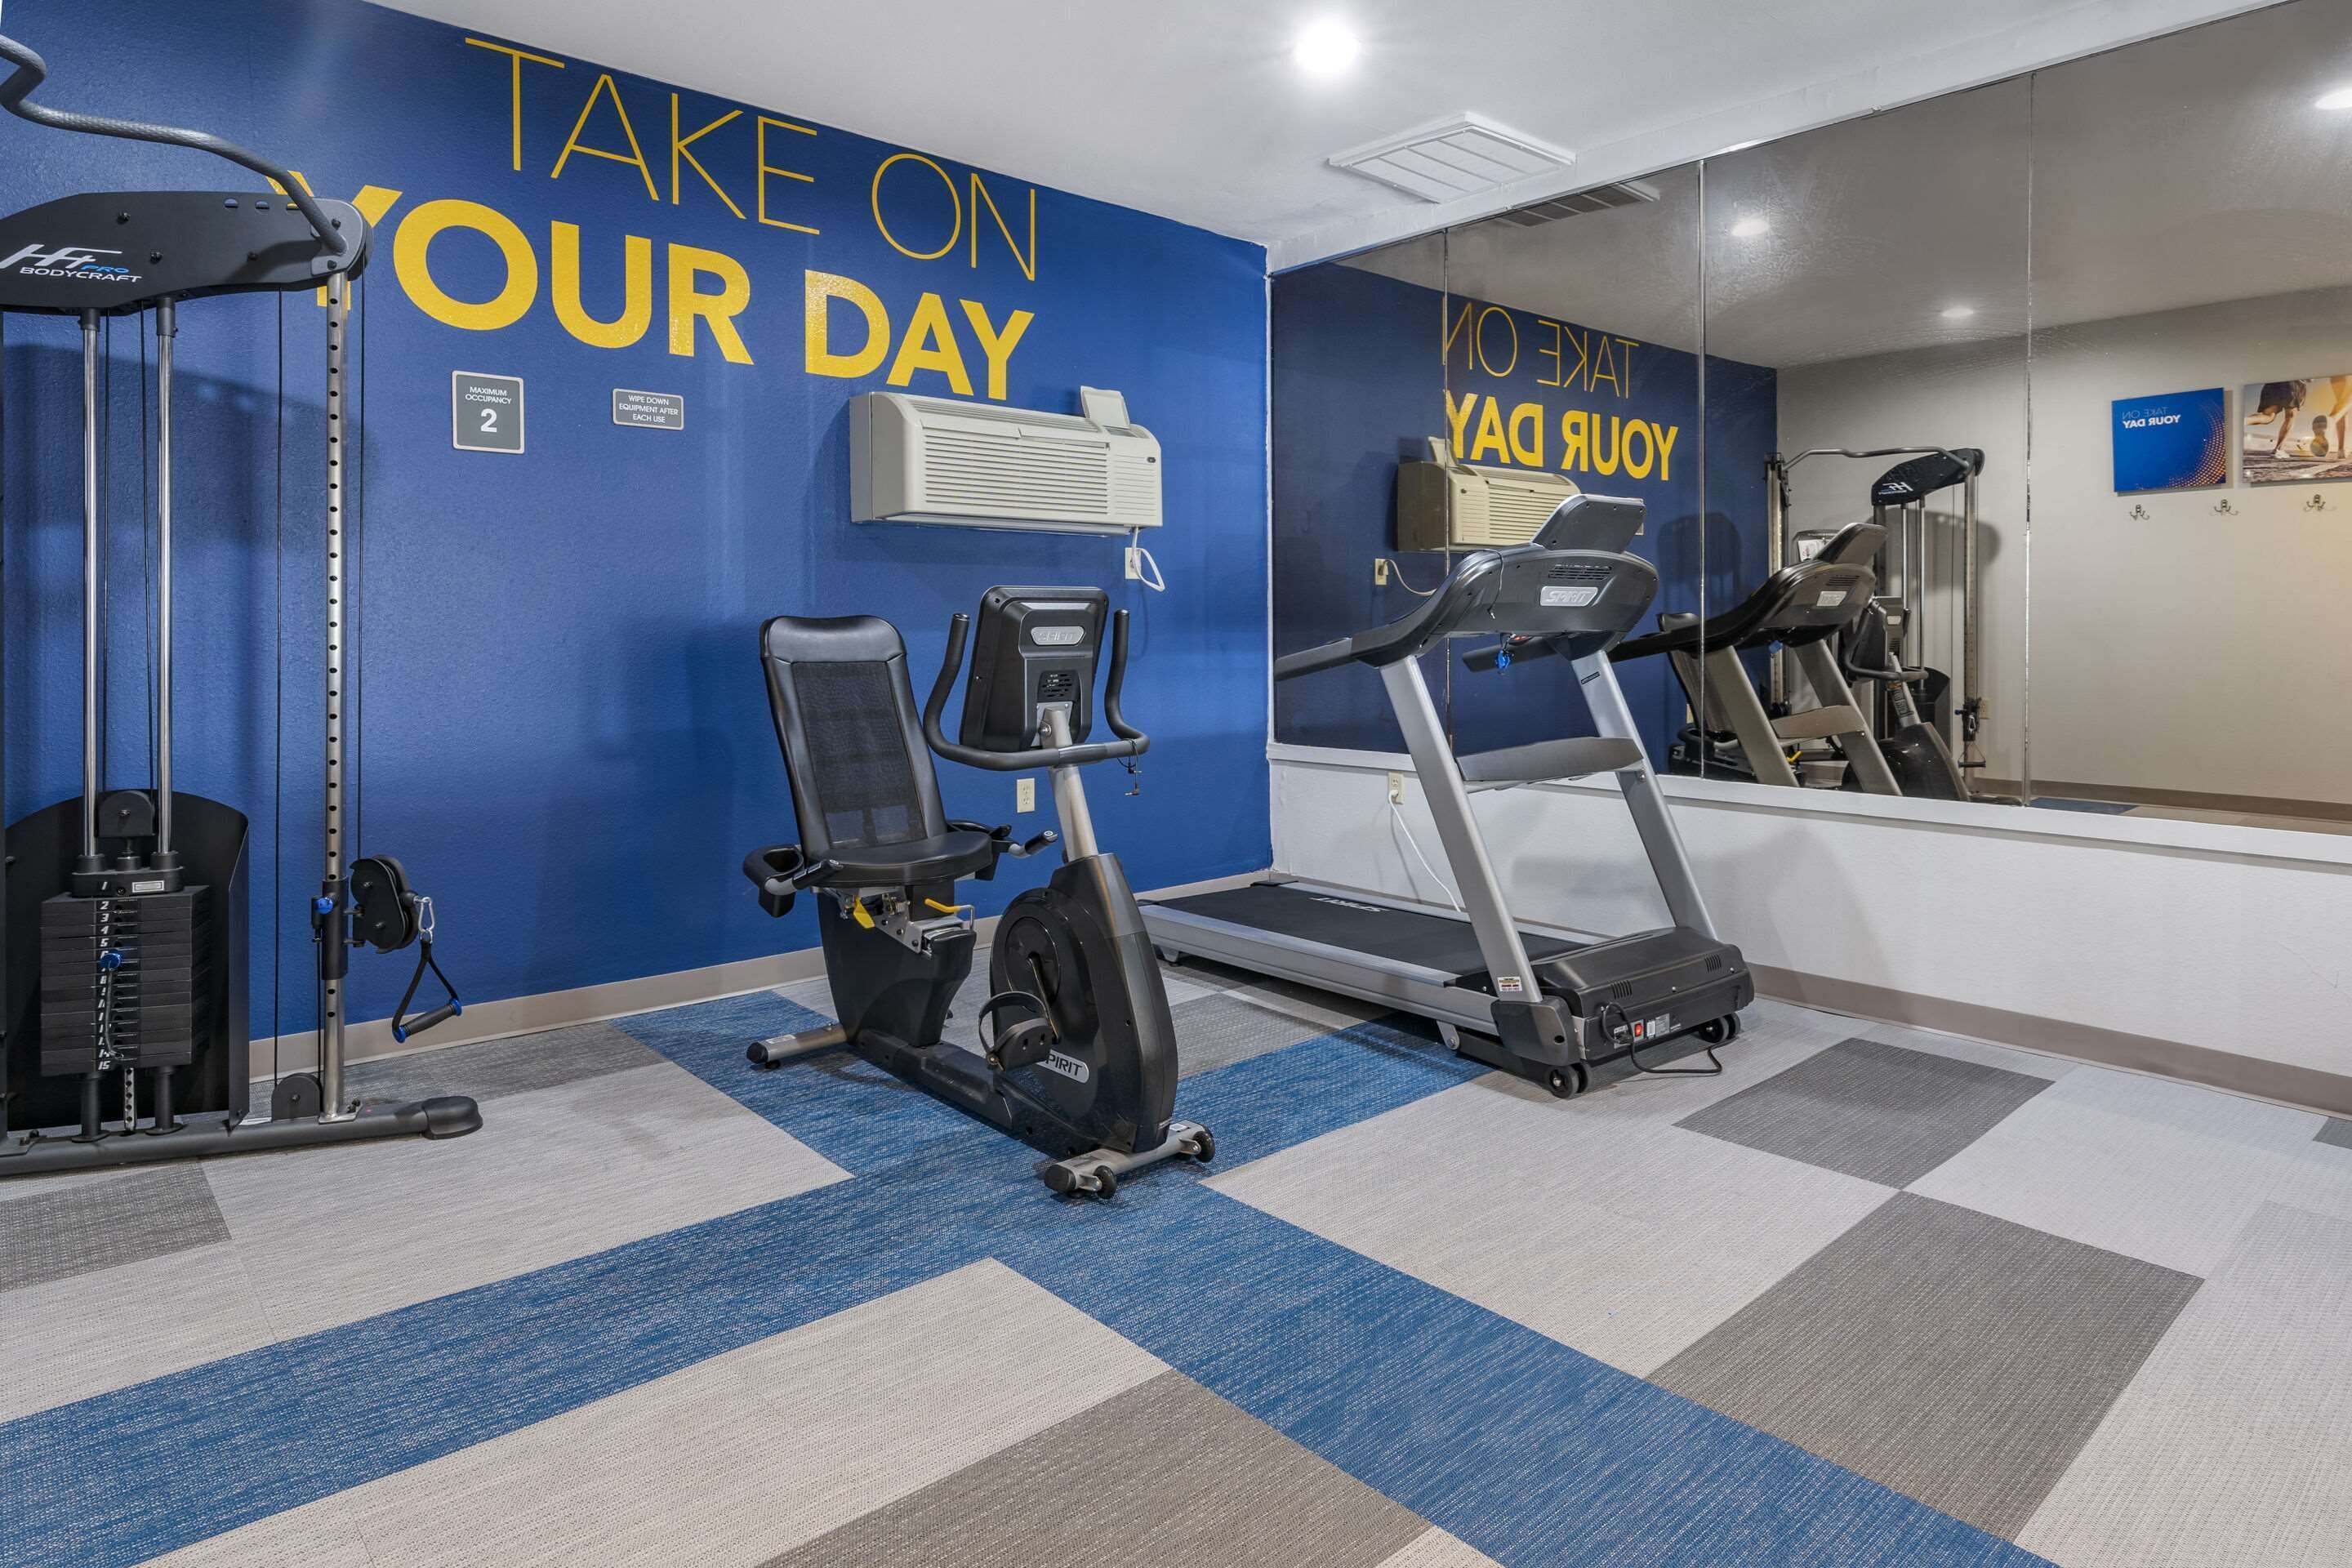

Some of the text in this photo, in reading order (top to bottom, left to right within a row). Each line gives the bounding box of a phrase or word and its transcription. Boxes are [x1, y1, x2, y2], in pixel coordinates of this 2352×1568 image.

[465, 38, 1036, 282] TAKE ON
[20, 266, 142, 283] BODYCRAFT
[81, 264, 130, 274] PRO
[804, 269, 1035, 400] DAY
[470, 386, 507, 397] MAXIMUM
[465, 393, 512, 405] OCCUPANCY
[628, 394, 669, 406] WIPE DOWN
[619, 403, 679, 416] EQUIPMENT AFTER
[480, 408, 497, 433] 2
[632, 413, 652, 421] EACH
[100, 901, 110, 910] 2
[100, 913, 110, 923] 3
[100, 925, 109, 935] 4
[100, 938, 109, 947] 5
[98, 1061, 111, 1071] 15
[1045, 1054, 1083, 1076] PIRIT
